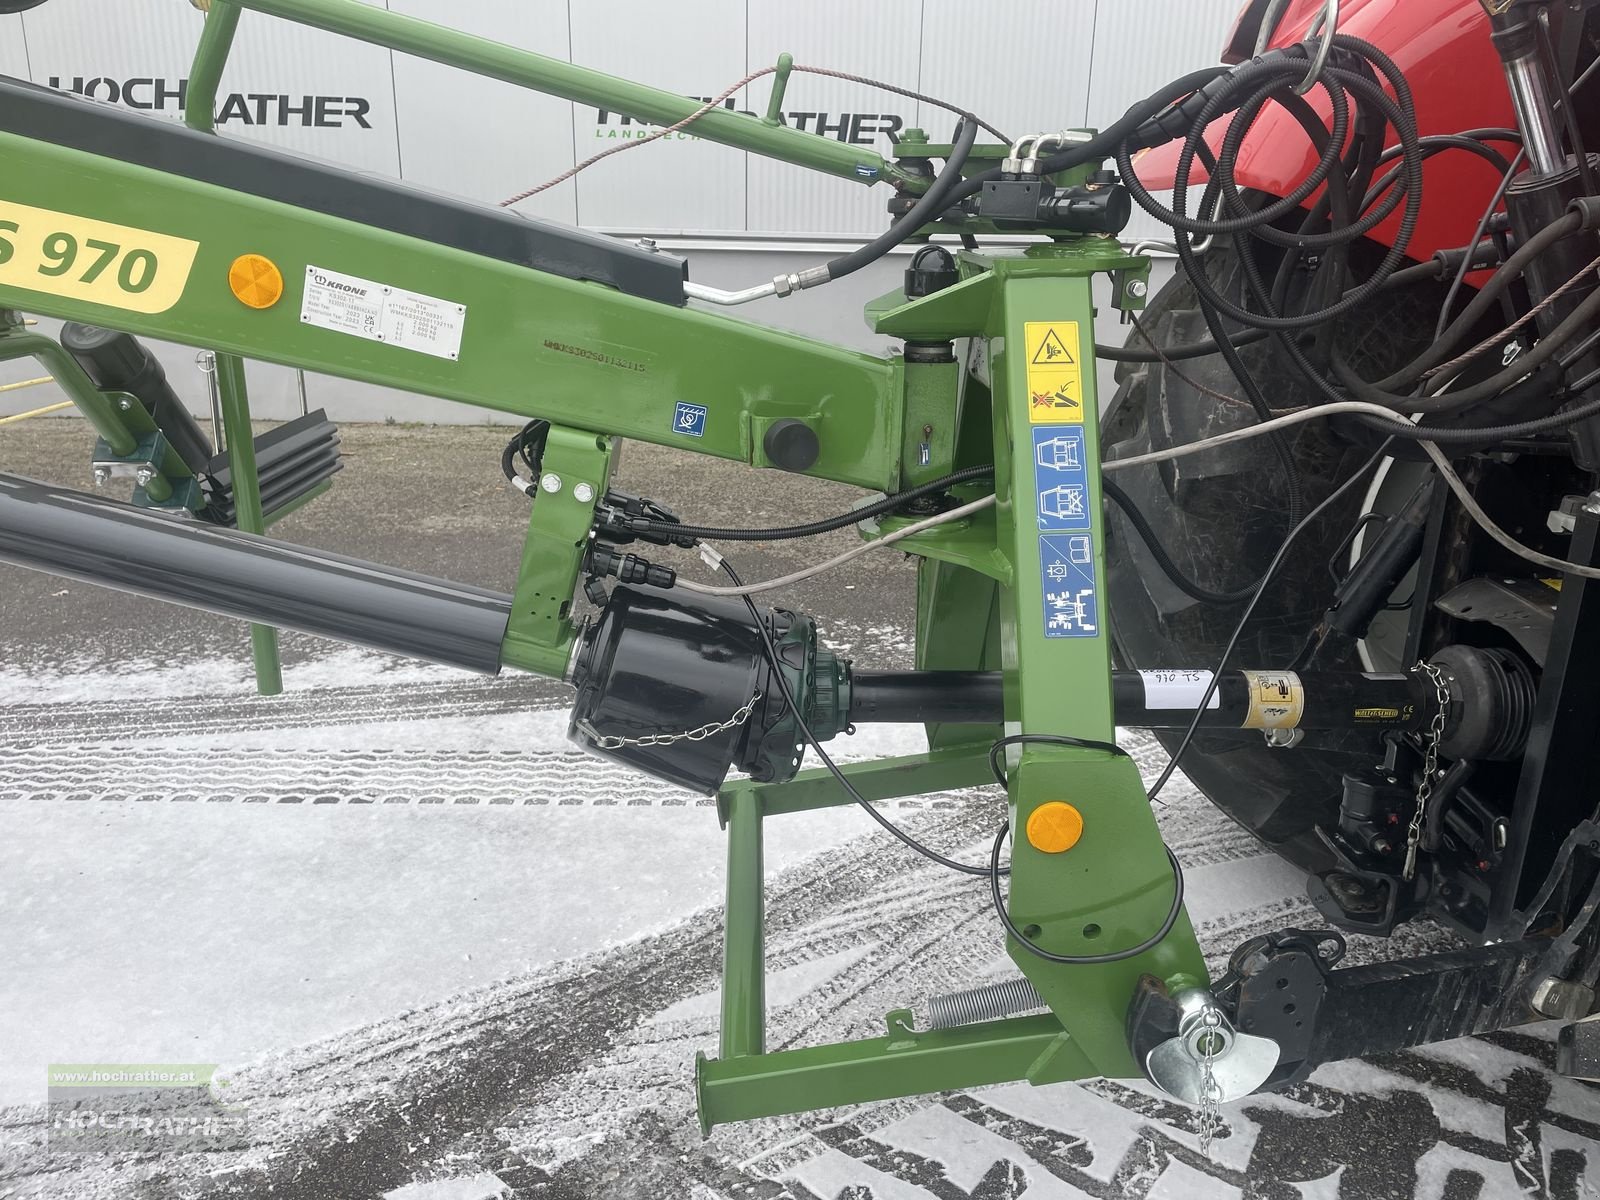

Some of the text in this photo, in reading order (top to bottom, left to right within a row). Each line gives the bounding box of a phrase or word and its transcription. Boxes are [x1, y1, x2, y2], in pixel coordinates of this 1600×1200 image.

[49, 77, 372, 129] HOCHATHER
[37, 232, 158, 294] 970
[327, 281, 367, 296] KRONE
[1182, 672, 1200, 682] TS
